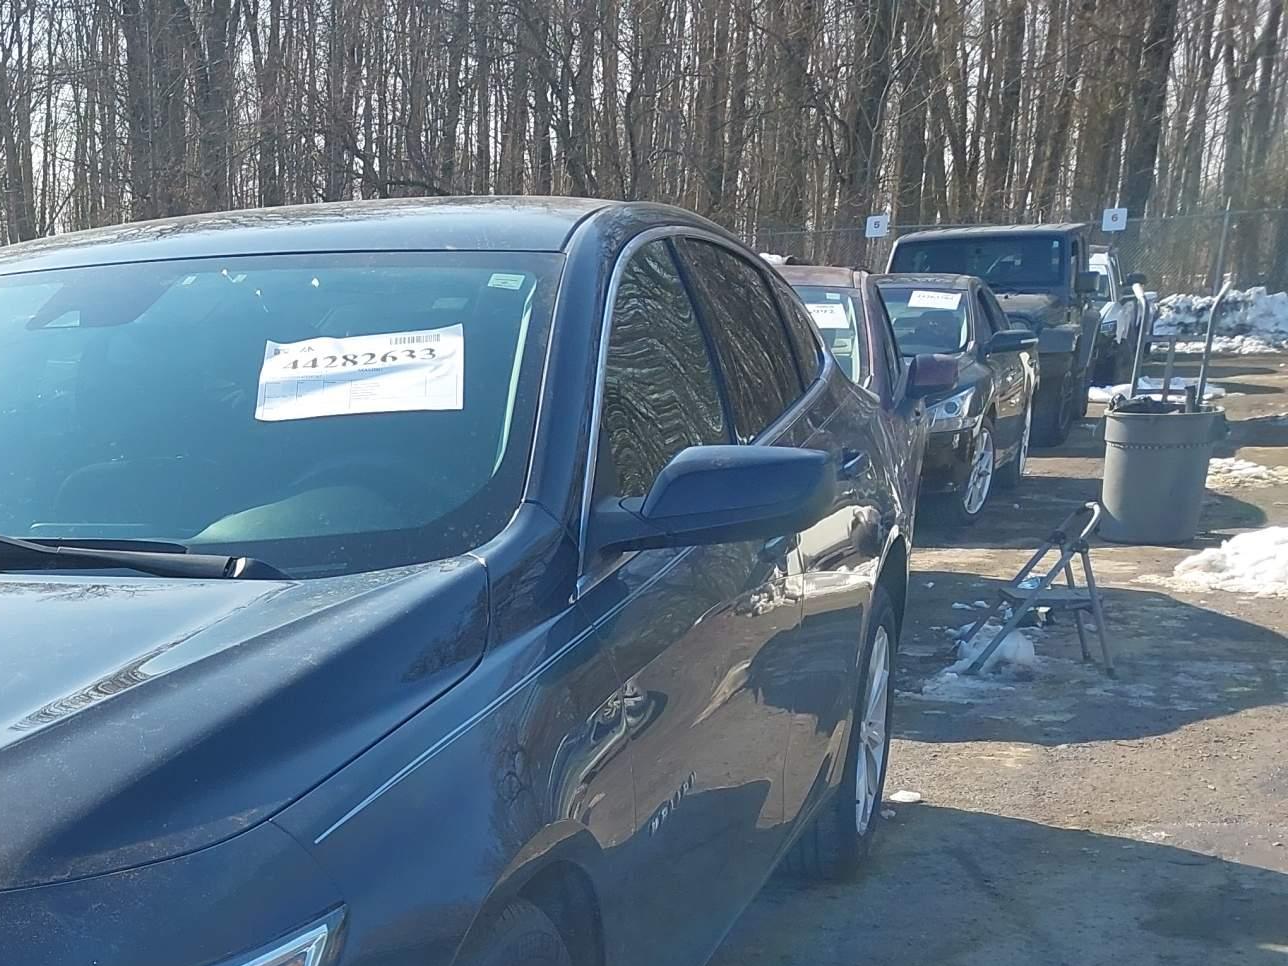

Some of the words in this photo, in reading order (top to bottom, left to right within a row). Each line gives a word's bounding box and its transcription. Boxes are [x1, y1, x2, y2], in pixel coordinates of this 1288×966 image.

[1111, 213, 1118, 222] 6
[873, 220, 880, 229] 5
[283, 347, 437, 370] 44282633
